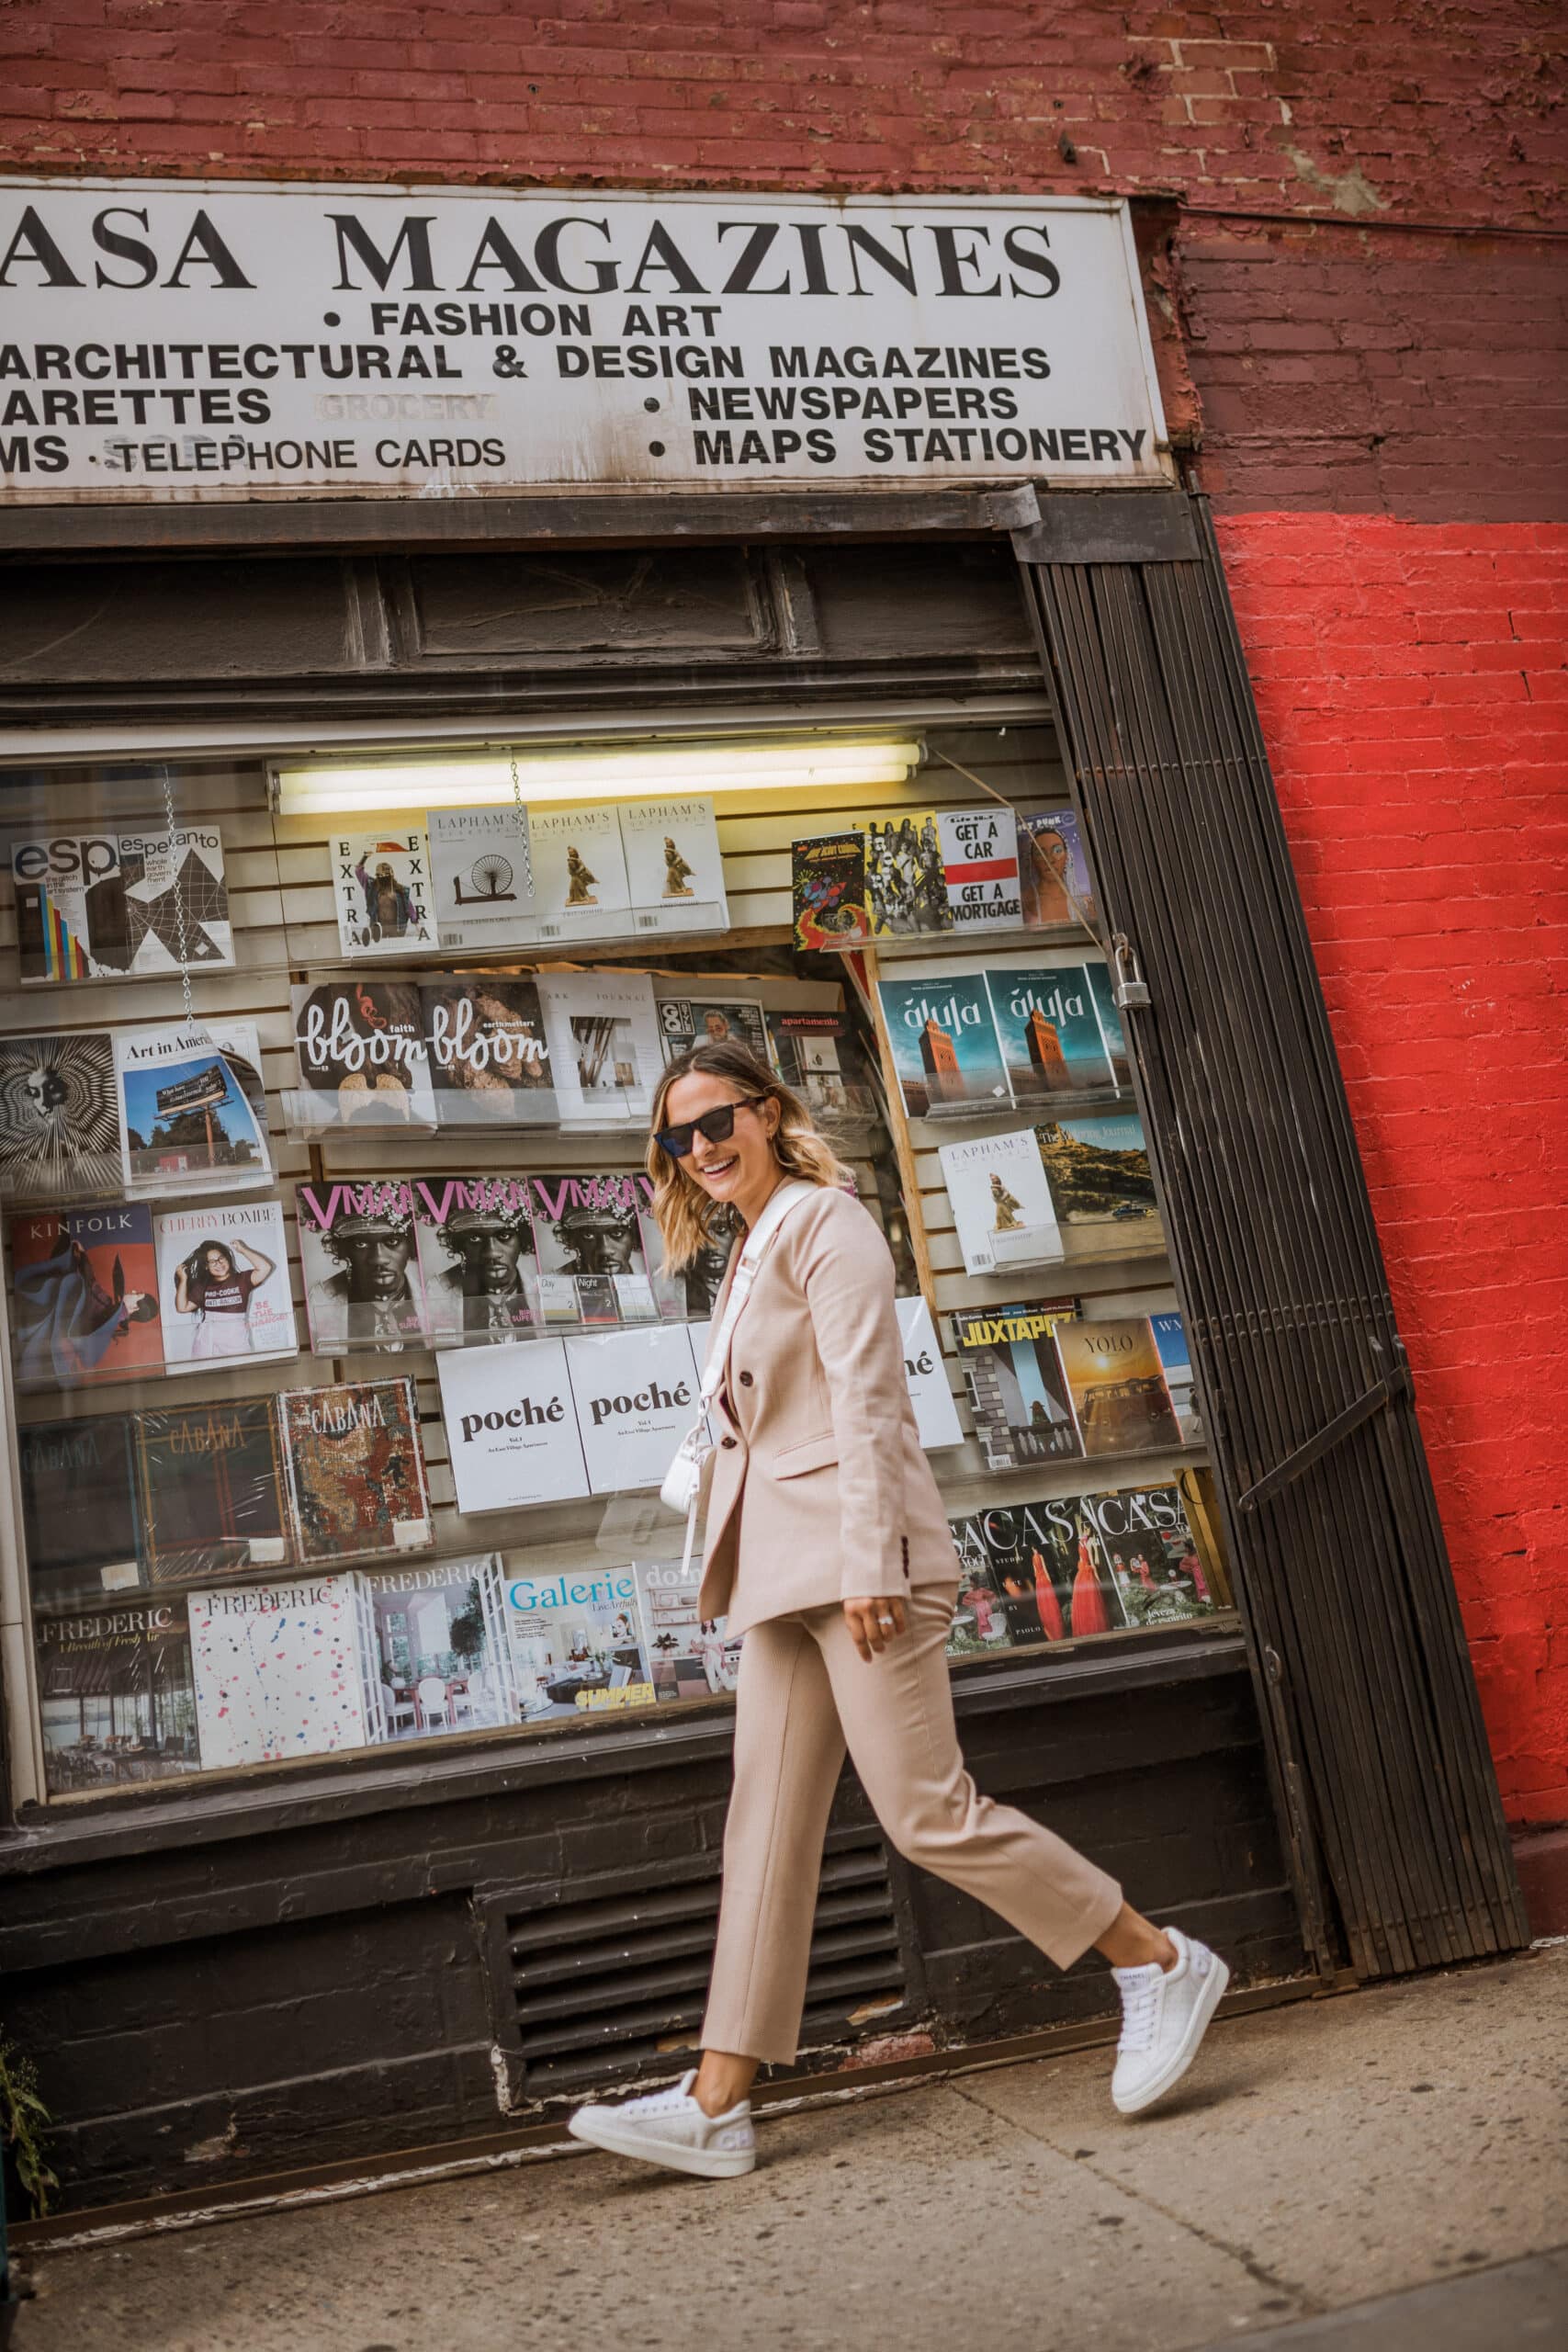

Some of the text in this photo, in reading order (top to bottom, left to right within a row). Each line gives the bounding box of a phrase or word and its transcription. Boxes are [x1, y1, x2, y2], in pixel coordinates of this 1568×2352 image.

[0, 205, 1061, 300] ASA MAGAZINES
[370, 301, 723, 336] FASHION ART
[0, 344, 1052, 379] ARCHITECTURAL & DESIGN MAGAZINES
[1, 388, 272, 425] ARETTES
[688, 386, 1019, 421] NEWSPAPERS
[113, 439, 358, 472] TELEPHONE
[375, 438, 506, 469] CARDS
[694, 428, 837, 465] MAPS
[864, 428, 1147, 462] STATIONERY
[955, 823, 978, 842] GET
[987, 821, 998, 839] A
[15, 838, 117, 886] esp
[964, 841, 994, 860] CAR
[951, 899, 1021, 922] MORTGAGE
[961, 883, 1004, 903] GET A
[294, 997, 427, 1071] bloom
[389, 1024, 414, 1034] faith
[424, 997, 549, 1070] bloom
[781, 1017, 839, 1025] apartamento
[127, 1045, 153, 1059] Art
[157, 1043, 173, 1055] in
[30, 1213, 134, 1239] KINFOLK
[579, 1278, 598, 1290] Night
[1085, 1334, 1134, 1354] YOLO
[311, 1394, 387, 1433] CABANA
[461, 1396, 565, 1442] poché
[589, 1381, 692, 1425] poché
[169, 1414, 247, 1454] CABANA
[367, 1564, 489, 1596] FREDERIC
[509, 1573, 635, 1611] Galerie
[208, 1585, 334, 1617] FREDERIC
[42, 1607, 174, 1644] FREDERIC
